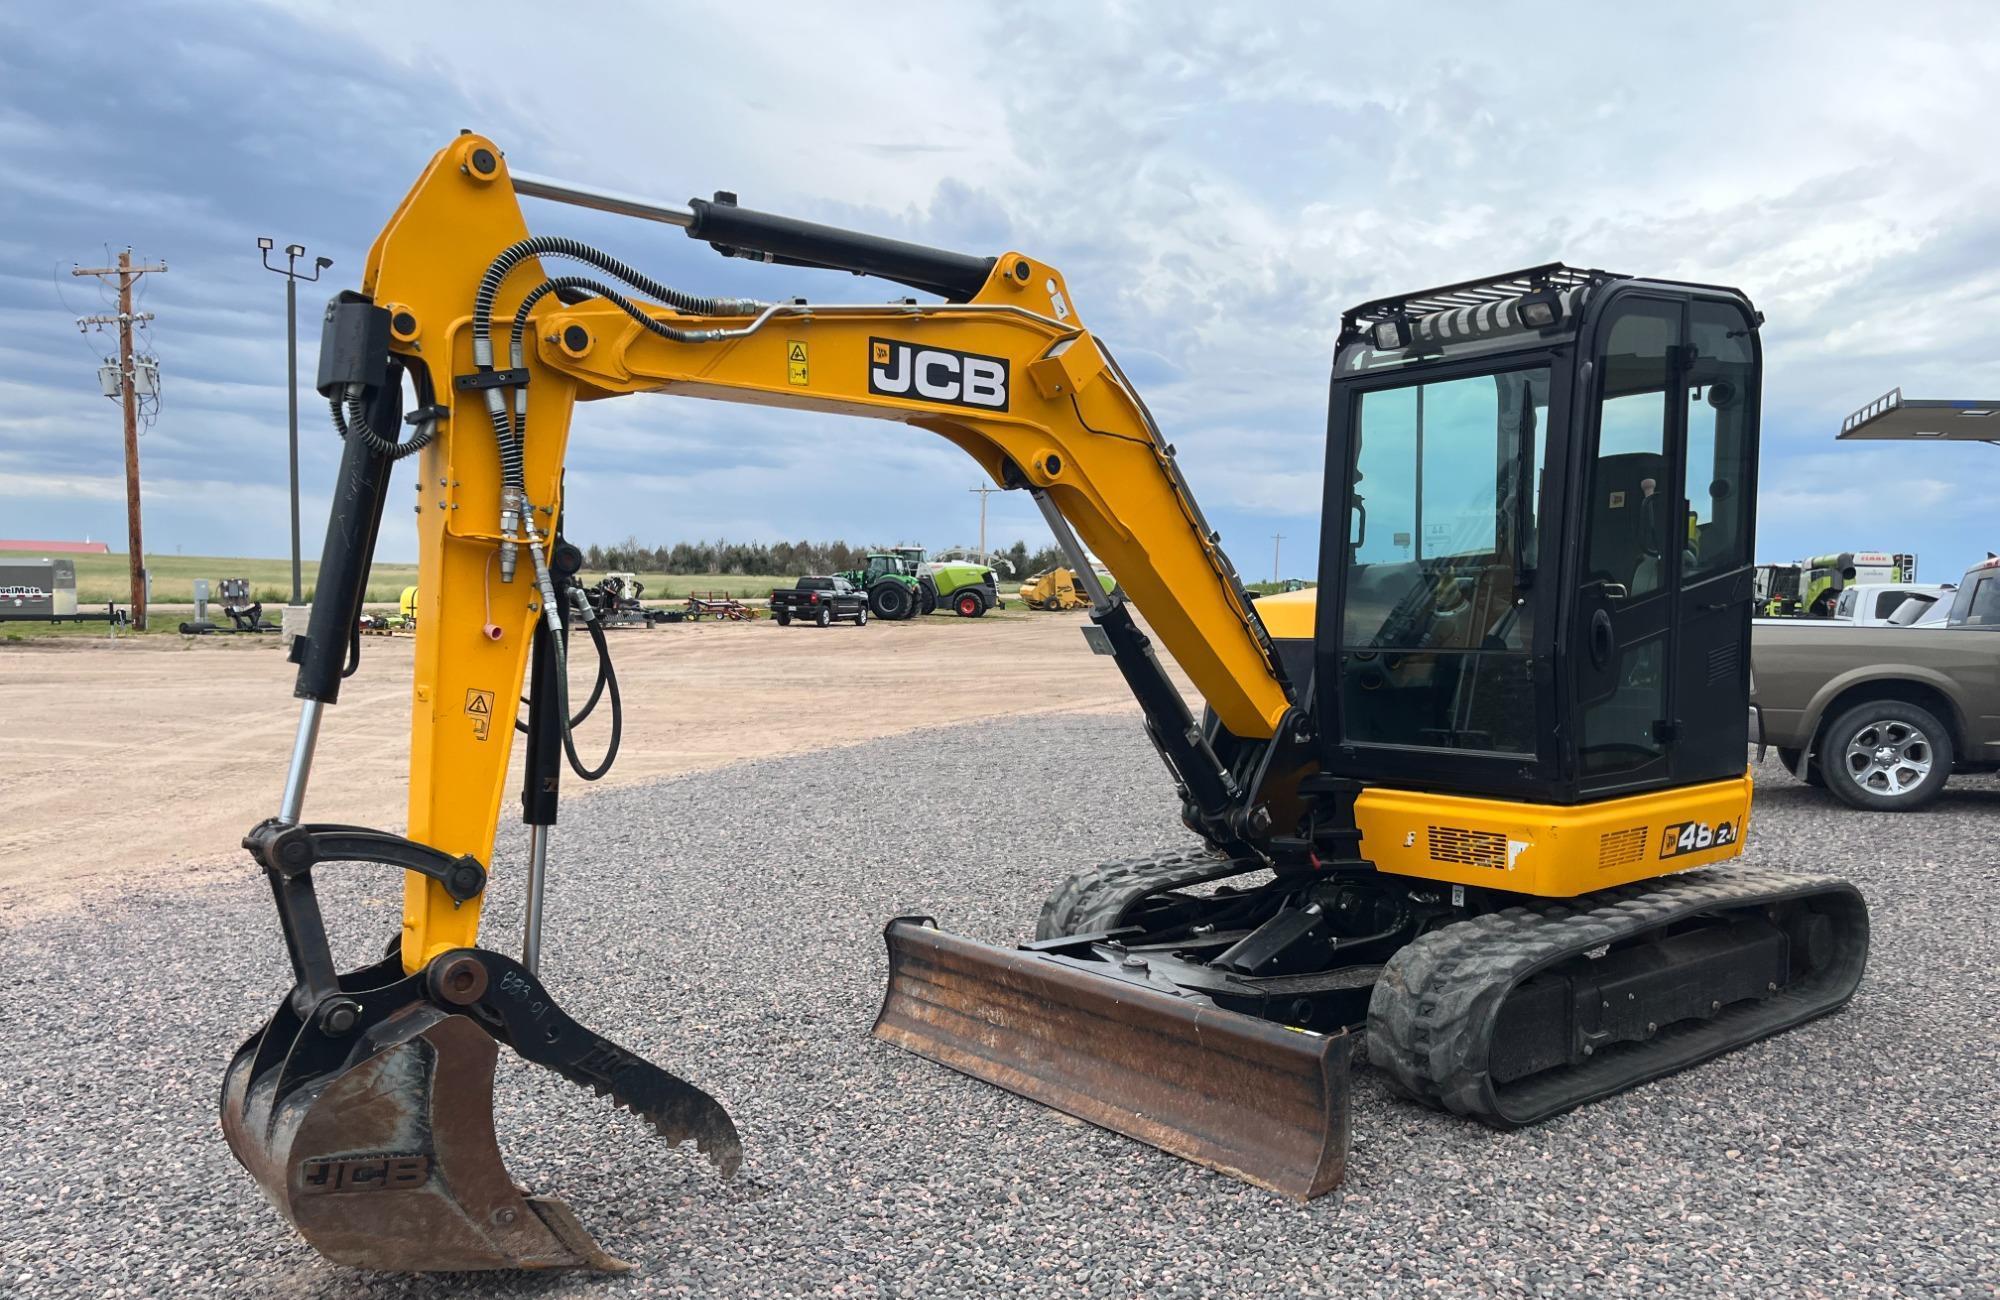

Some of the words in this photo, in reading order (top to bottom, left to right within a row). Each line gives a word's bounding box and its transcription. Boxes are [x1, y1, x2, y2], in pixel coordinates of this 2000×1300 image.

[873, 346, 1006, 407] JCB
[0, 586, 39, 594] uelMate
[304, 1157, 428, 1191] JCB
